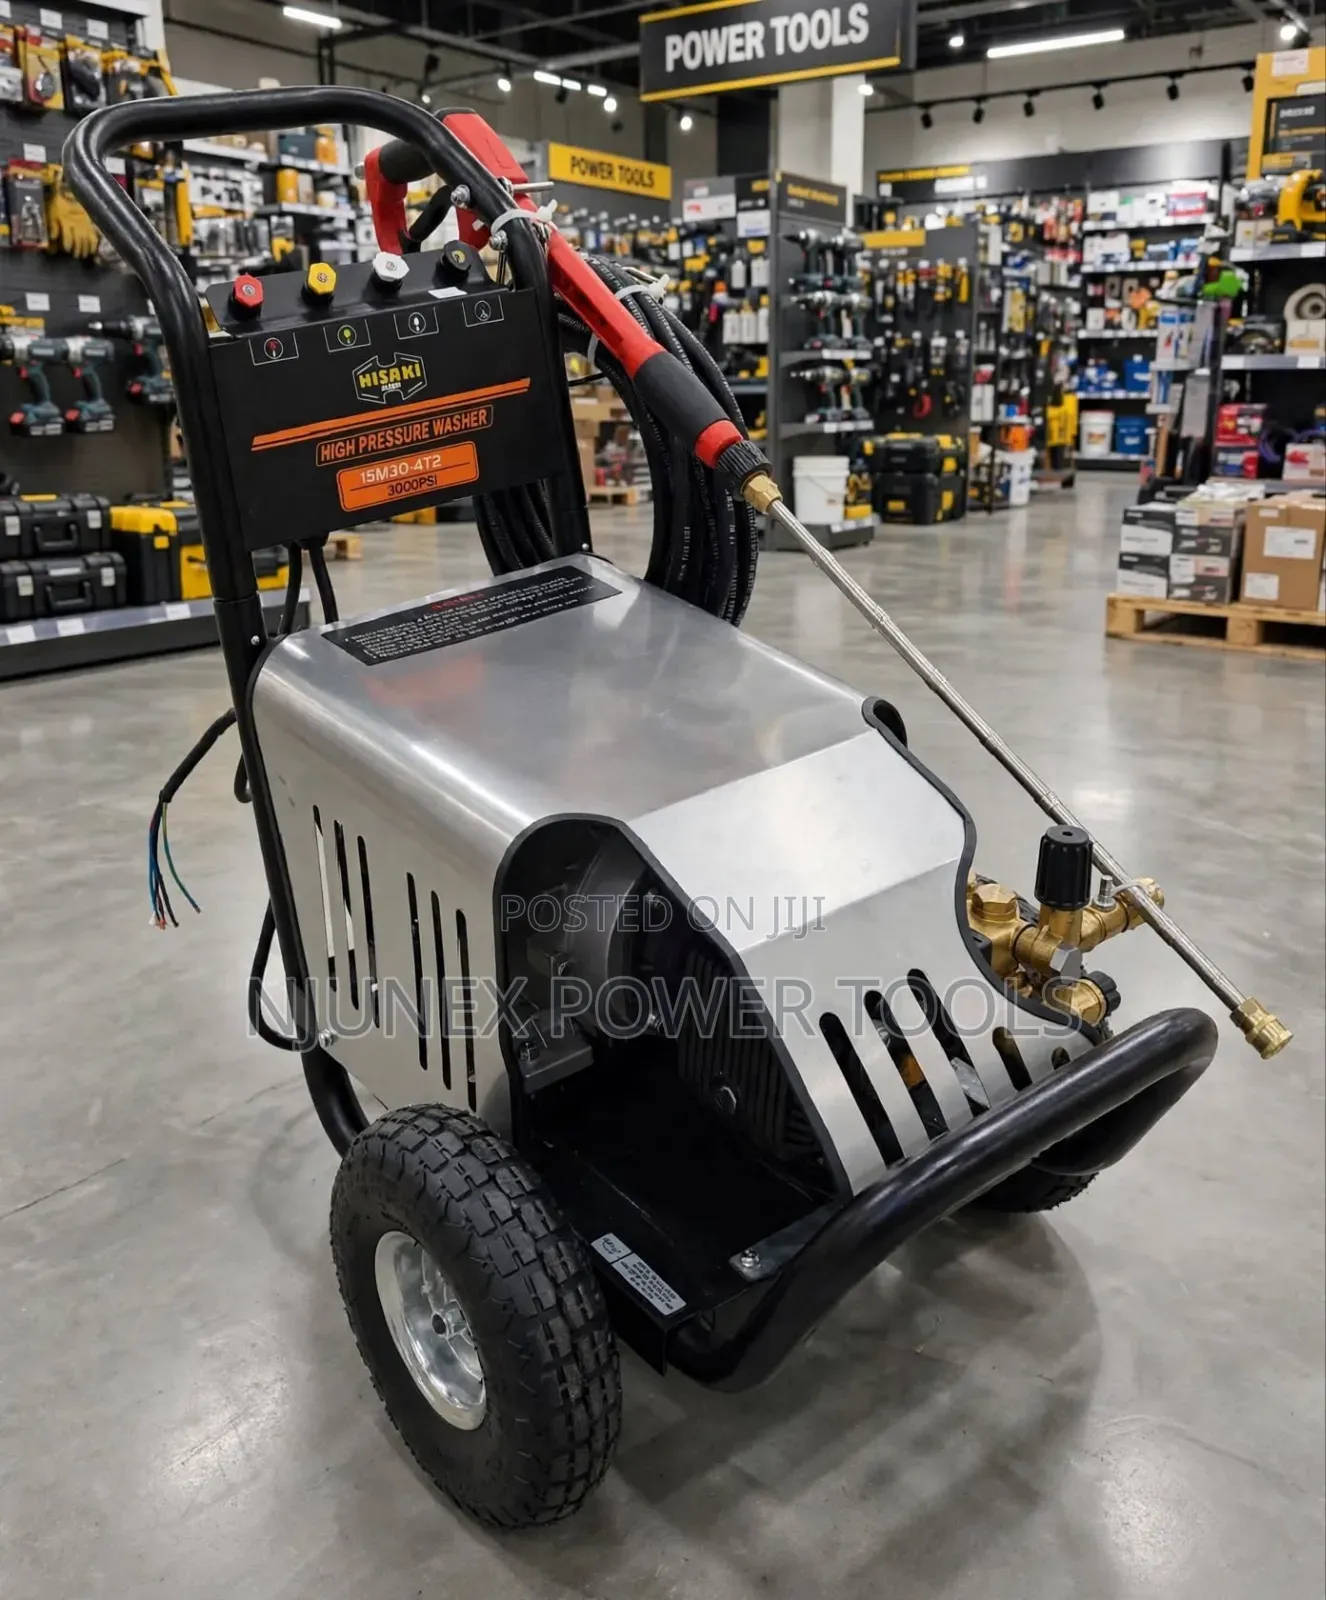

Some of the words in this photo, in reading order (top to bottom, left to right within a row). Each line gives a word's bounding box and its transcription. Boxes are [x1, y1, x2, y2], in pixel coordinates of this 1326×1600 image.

[665, 21, 765, 73] POWER
[769, 2, 869, 56] TOOLS
[570, 155, 616, 181] POWER
[617, 164, 655, 188] TOOLS
[359, 363, 422, 388] HISAKI
[321, 439, 356, 461] HIGH
[359, 421, 430, 454] PRESSURE
[433, 408, 488, 436] WASHER
[361, 454, 442, 484] 15M30-4T2
[388, 475, 438, 496] 3000PSI
